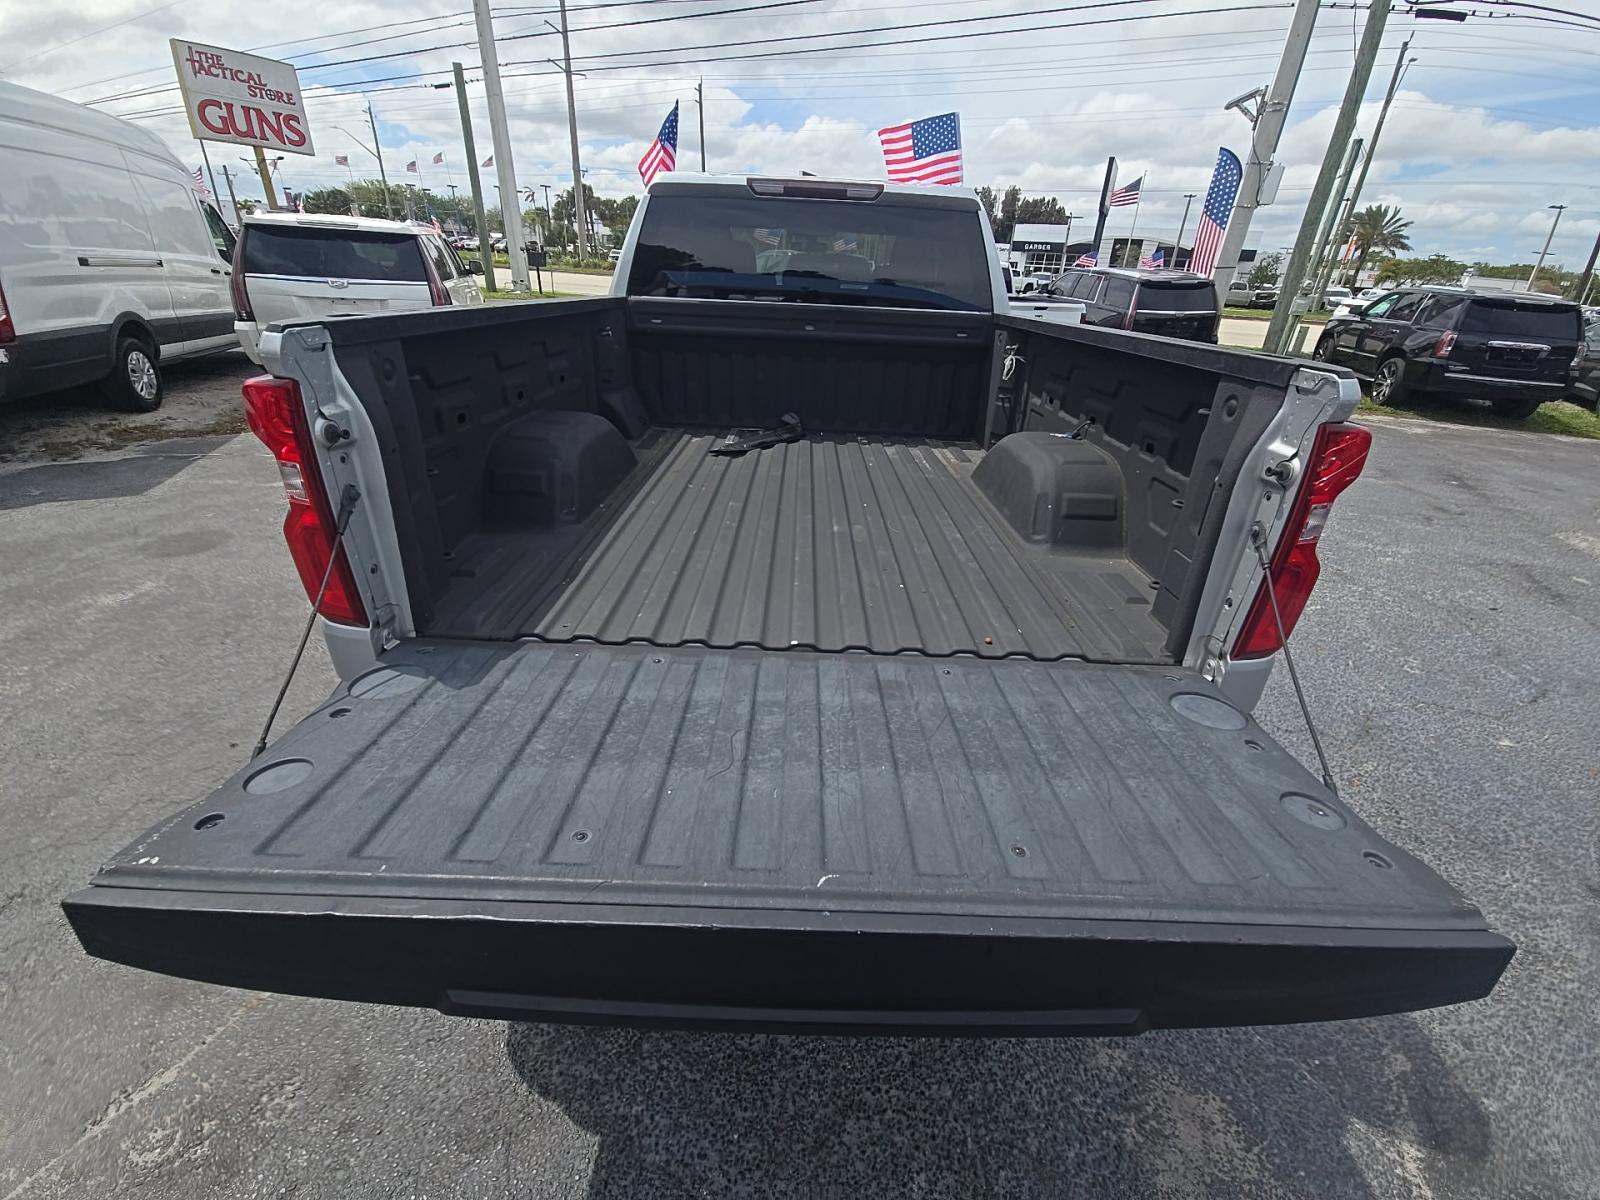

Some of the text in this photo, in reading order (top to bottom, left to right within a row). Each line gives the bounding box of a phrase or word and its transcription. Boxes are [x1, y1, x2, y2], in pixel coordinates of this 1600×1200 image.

[187, 56, 267, 87] TACTICAL
[194, 51, 224, 67] THE
[247, 85, 296, 105] STORE
[197, 98, 306, 147] GUNS
